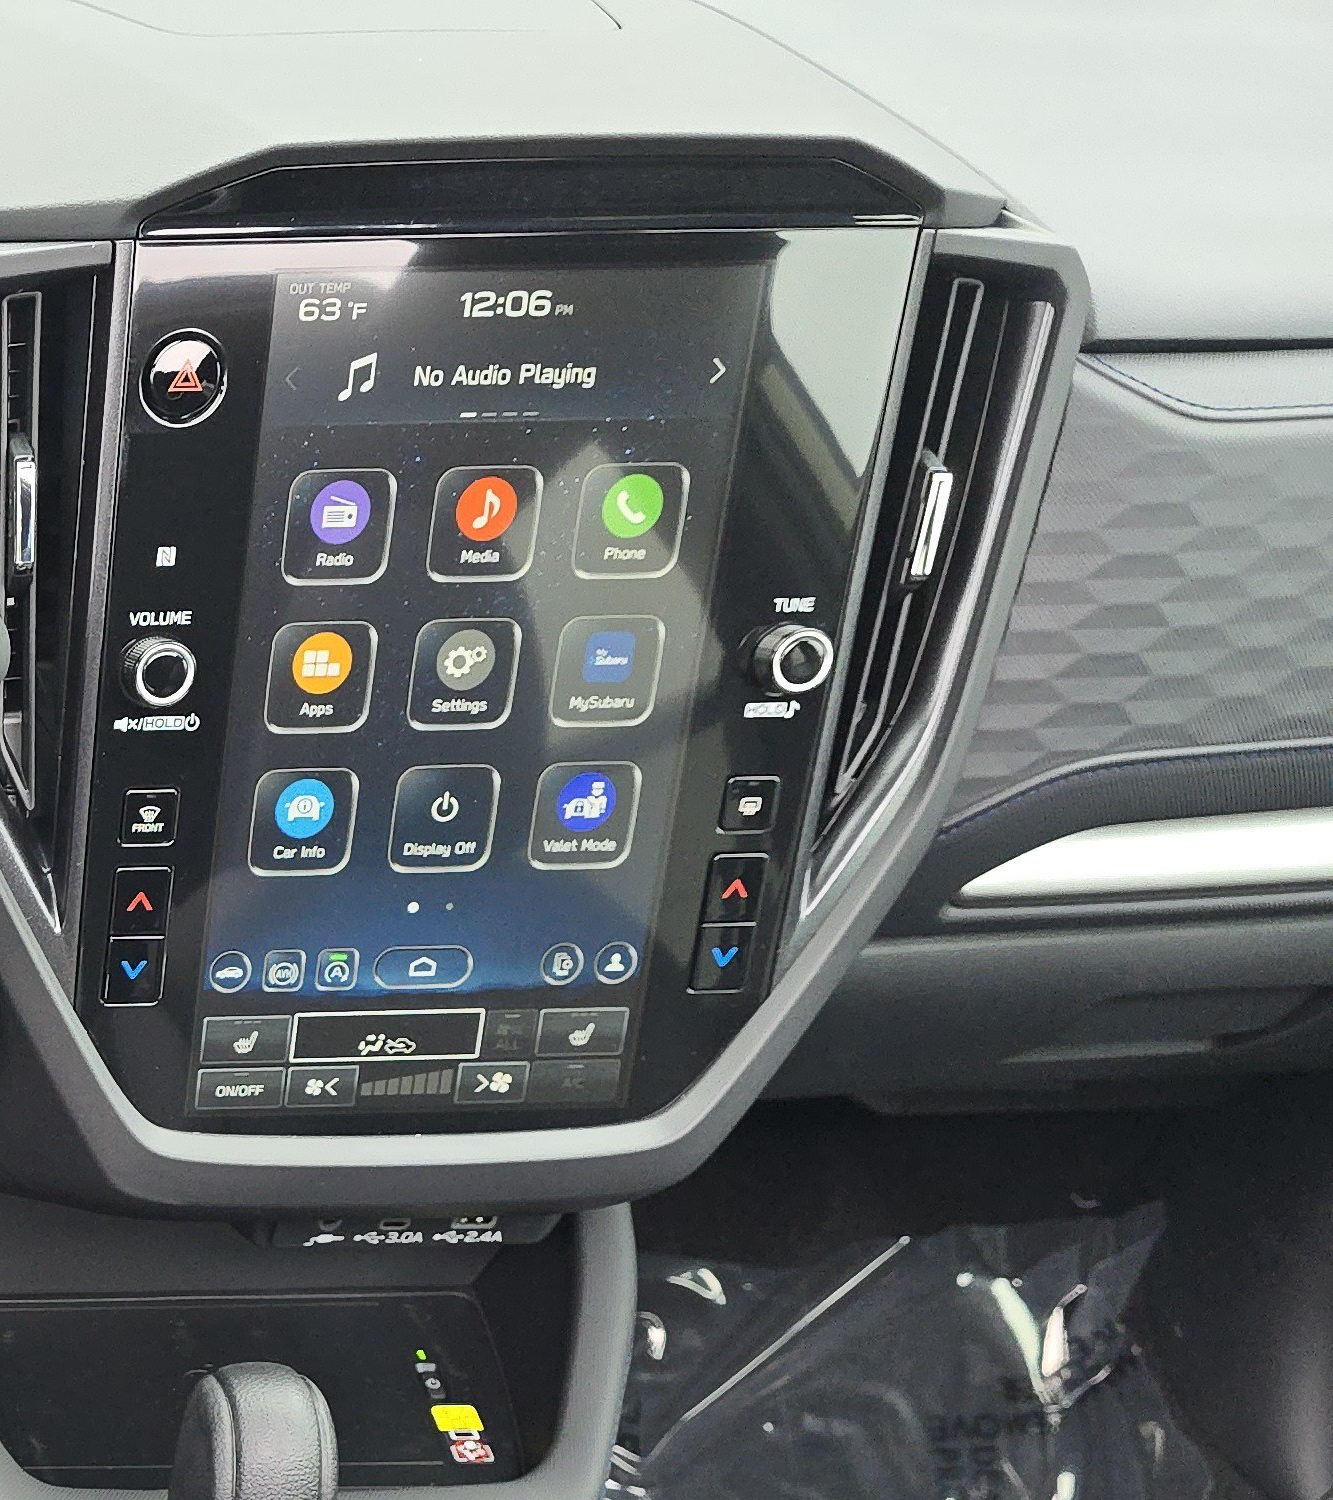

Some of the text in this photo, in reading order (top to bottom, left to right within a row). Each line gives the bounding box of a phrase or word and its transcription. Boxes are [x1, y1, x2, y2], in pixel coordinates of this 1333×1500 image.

[289, 282, 351, 295] OUT TEMP
[298, 298, 341, 321] 63
[460, 289, 574, 318] 12:06 PM
[413, 362, 596, 390] No Audio Playing
[315, 552, 354, 568] Radio
[459, 549, 500, 564] Media
[604, 546, 646, 562] Phone
[773, 597, 817, 613] TUNE
[129, 611, 193, 626] VOLUME
[299, 702, 334, 718] Apps
[431, 698, 488, 714] Settings
[569, 695, 636, 711] MySubaru
[144, 717, 184, 729] HOLD
[131, 822, 165, 833] FRONT
[272, 844, 326, 860] Car Info
[403, 841, 477, 858] Display Off
[543, 838, 617, 852] Valet Mode
[215, 1083, 264, 1098] ON/OFF
